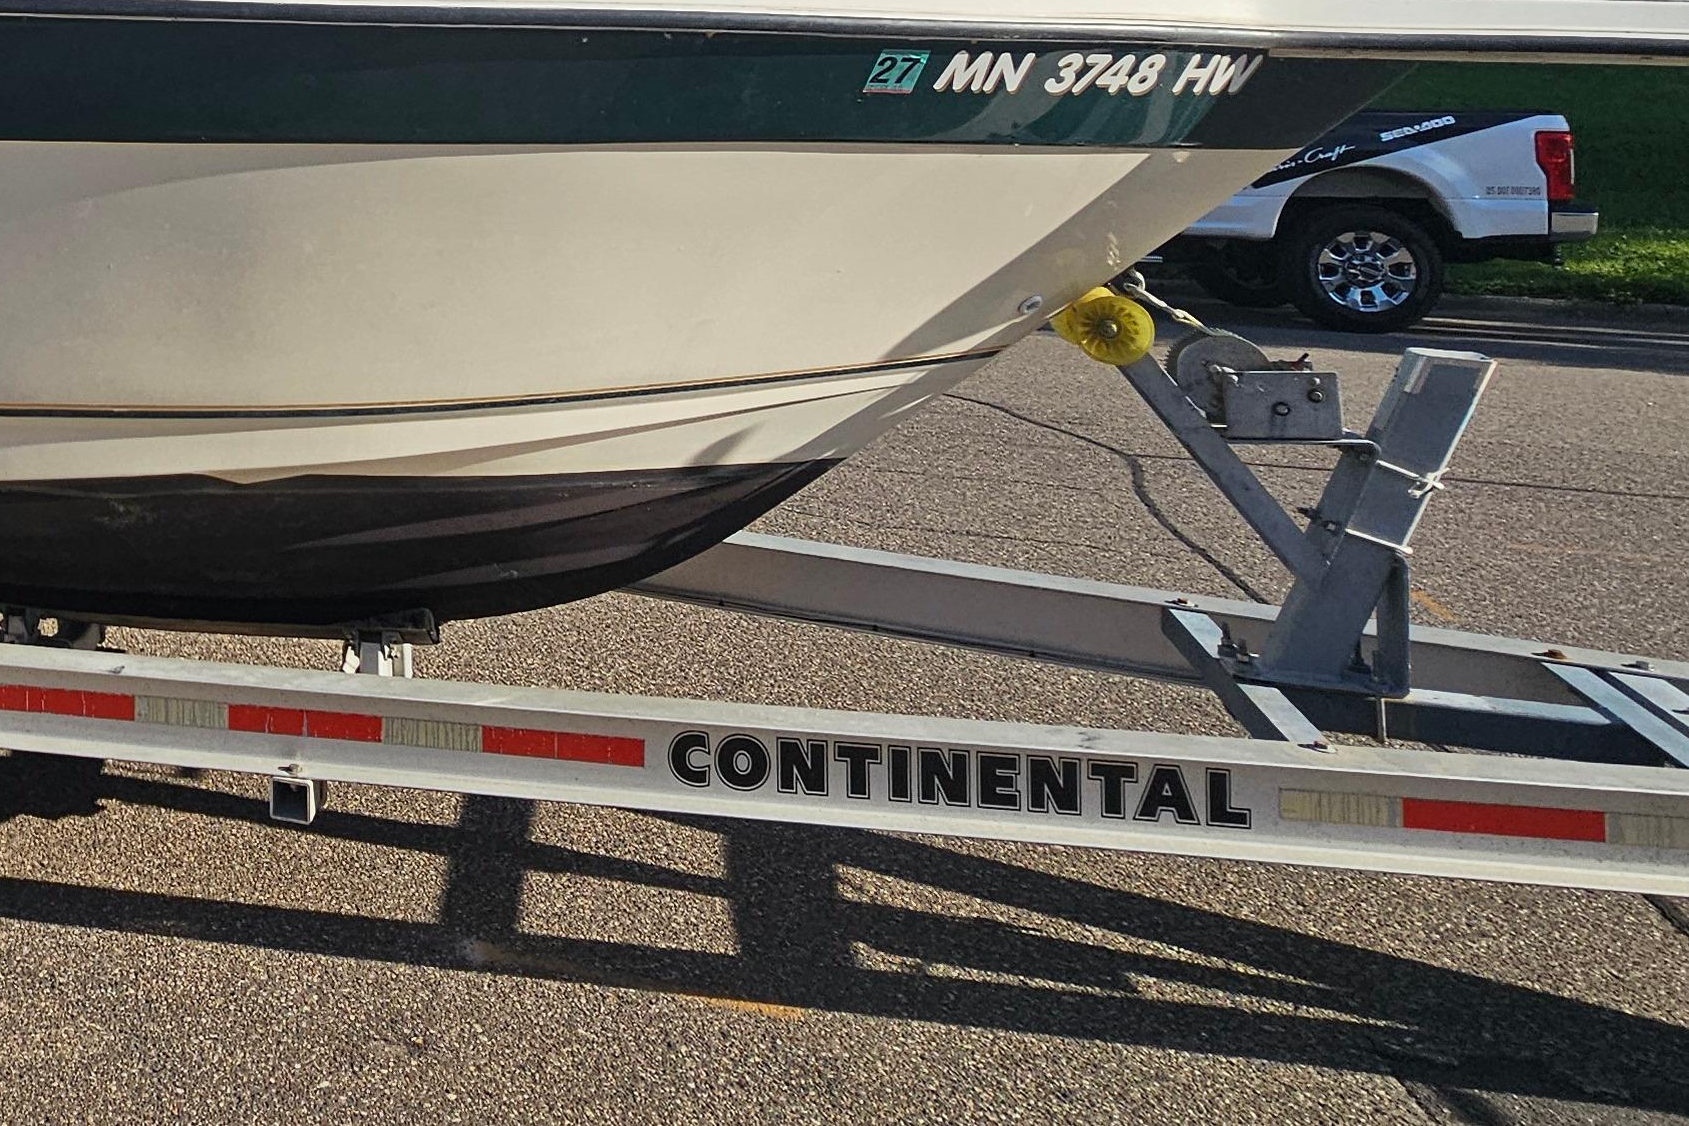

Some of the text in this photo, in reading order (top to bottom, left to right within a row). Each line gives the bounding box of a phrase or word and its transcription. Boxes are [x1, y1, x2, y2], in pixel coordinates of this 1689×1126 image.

[868, 55, 922, 84] 27
[933, 51, 1264, 96] MN 3748 HW
[668, 730, 1252, 830] CONTINENTAL
